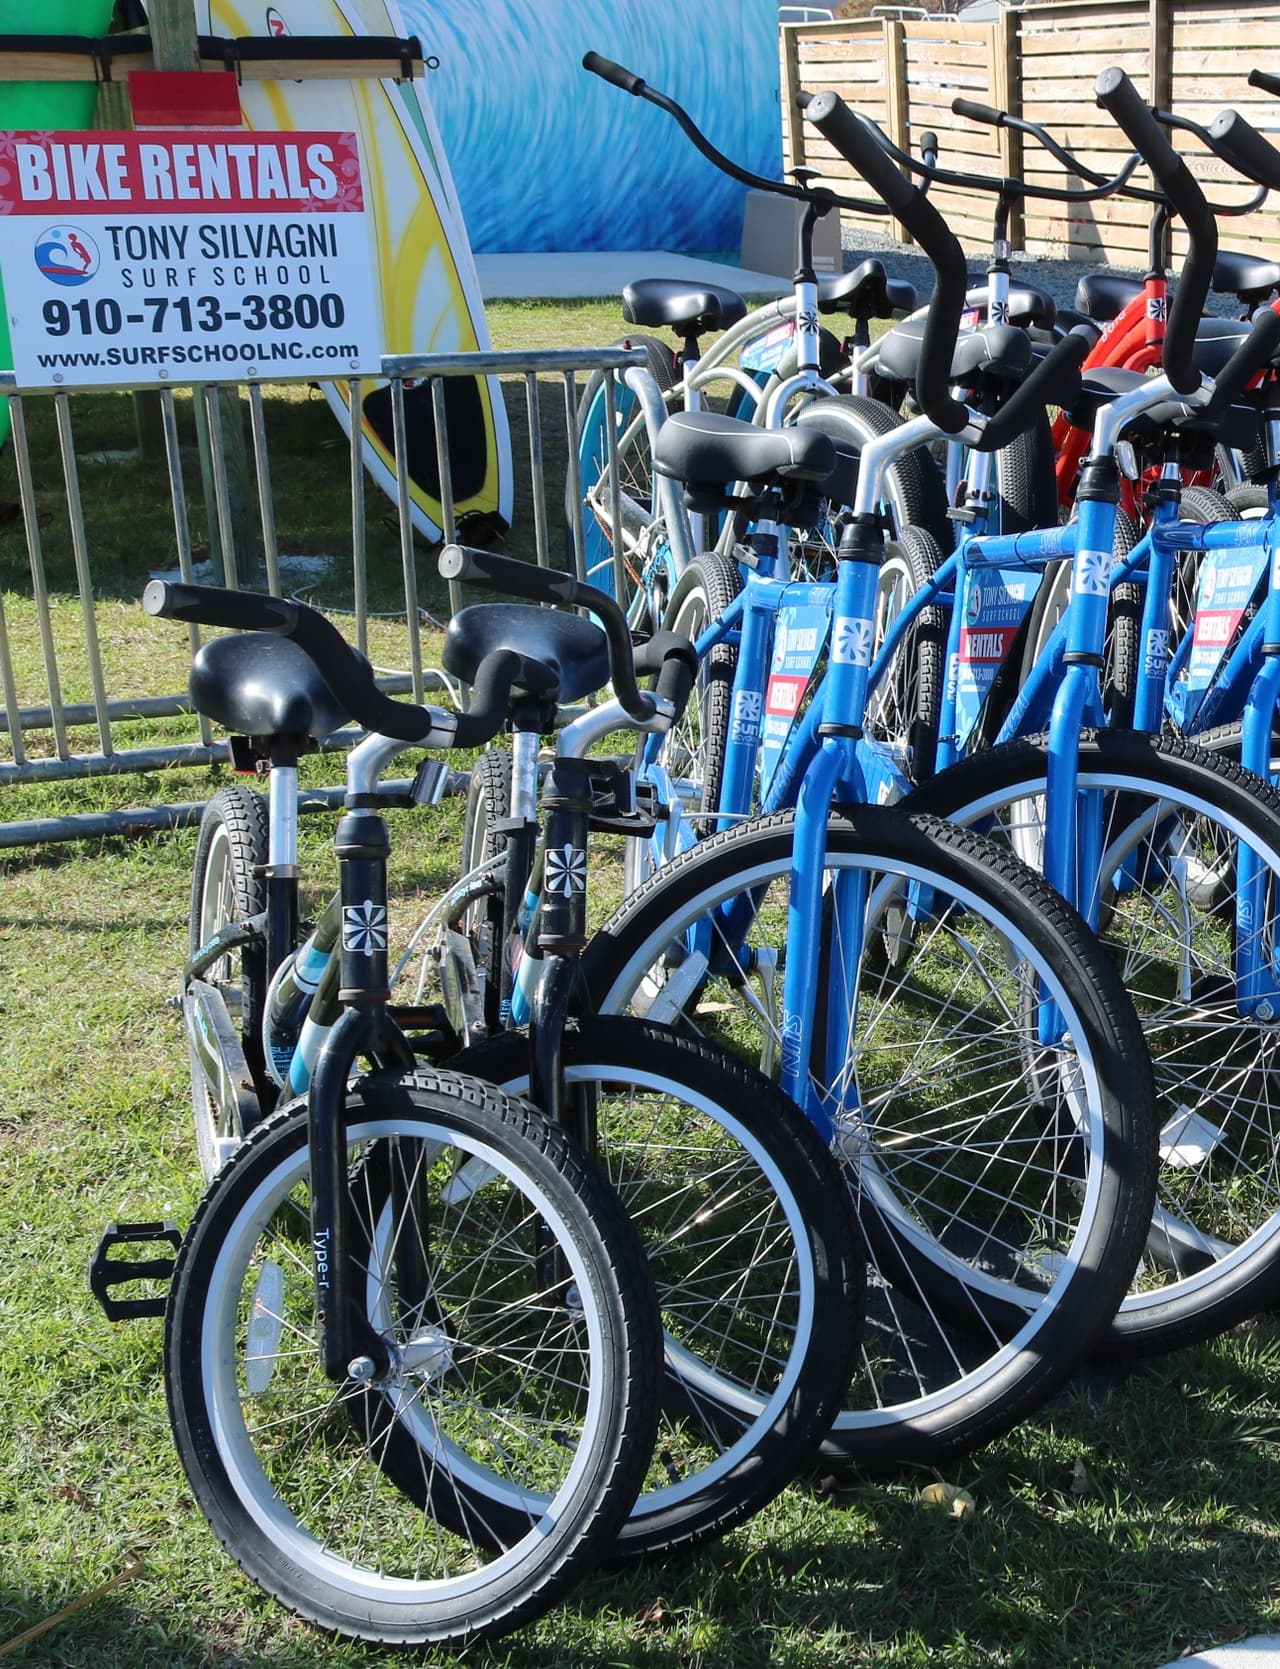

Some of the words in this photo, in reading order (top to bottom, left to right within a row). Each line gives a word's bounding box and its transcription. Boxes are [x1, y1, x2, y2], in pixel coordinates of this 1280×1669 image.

[15, 143, 132, 201] BIKE
[138, 143, 341, 201] RENTALS
[105, 225, 189, 262] TONY
[199, 223, 338, 260] SILVAGNI
[121, 266, 197, 288] SURF
[214, 265, 331, 286] SCHOOL
[42, 293, 346, 337] 910-713-3800
[37, 342, 360, 368] www.SURFSCHOOLNC.com
[965, 633, 1004, 659] RENTALS
[732, 720, 760, 737] Sun
[782, 1009, 802, 1078] SUN
[313, 1227, 330, 1289] Type-r
